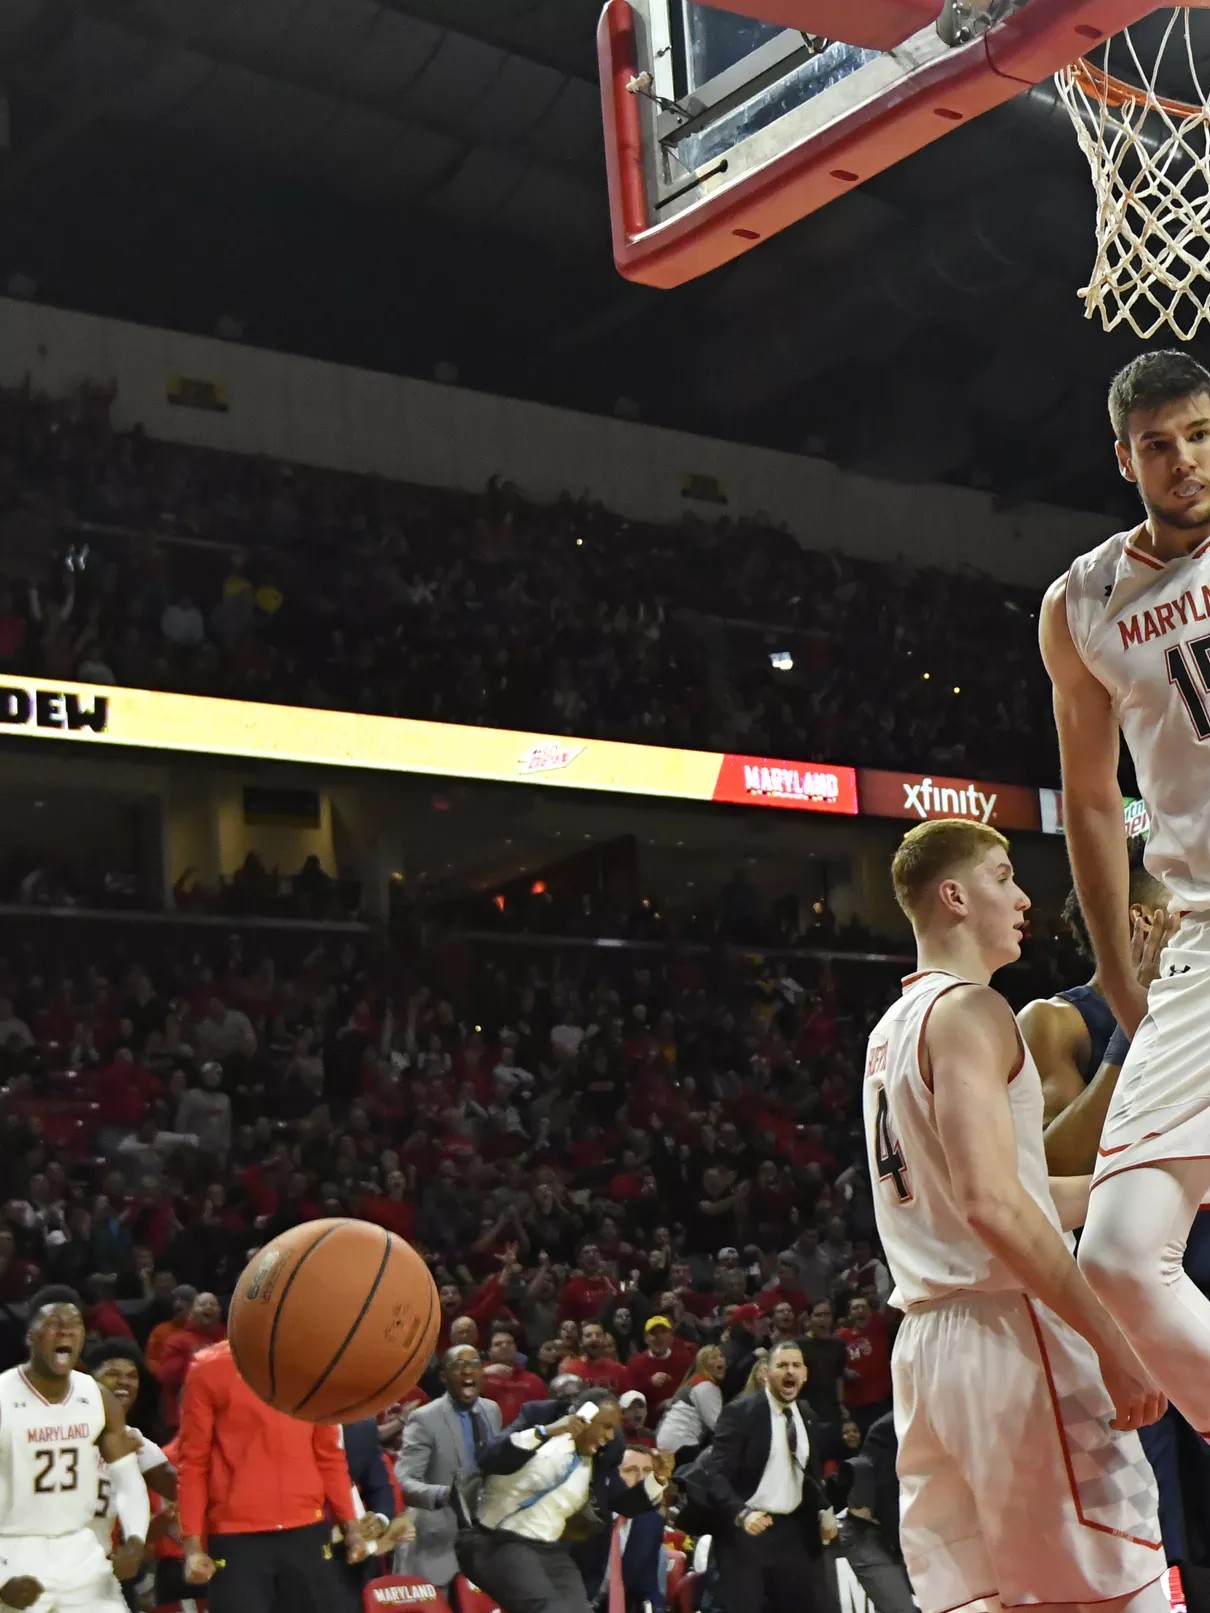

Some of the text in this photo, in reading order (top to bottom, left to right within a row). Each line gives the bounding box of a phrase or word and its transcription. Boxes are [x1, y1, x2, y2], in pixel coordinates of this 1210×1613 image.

[0, 687, 109, 733] DEW
[744, 765, 838, 798] MARYLAND
[903, 777, 997, 822] xfinity
[876, 1084, 914, 1205] 4
[27, 1423, 90, 1443] MARYLAND
[33, 1446, 79, 1494] 23
[374, 1583, 437, 1602] MARYLAND
